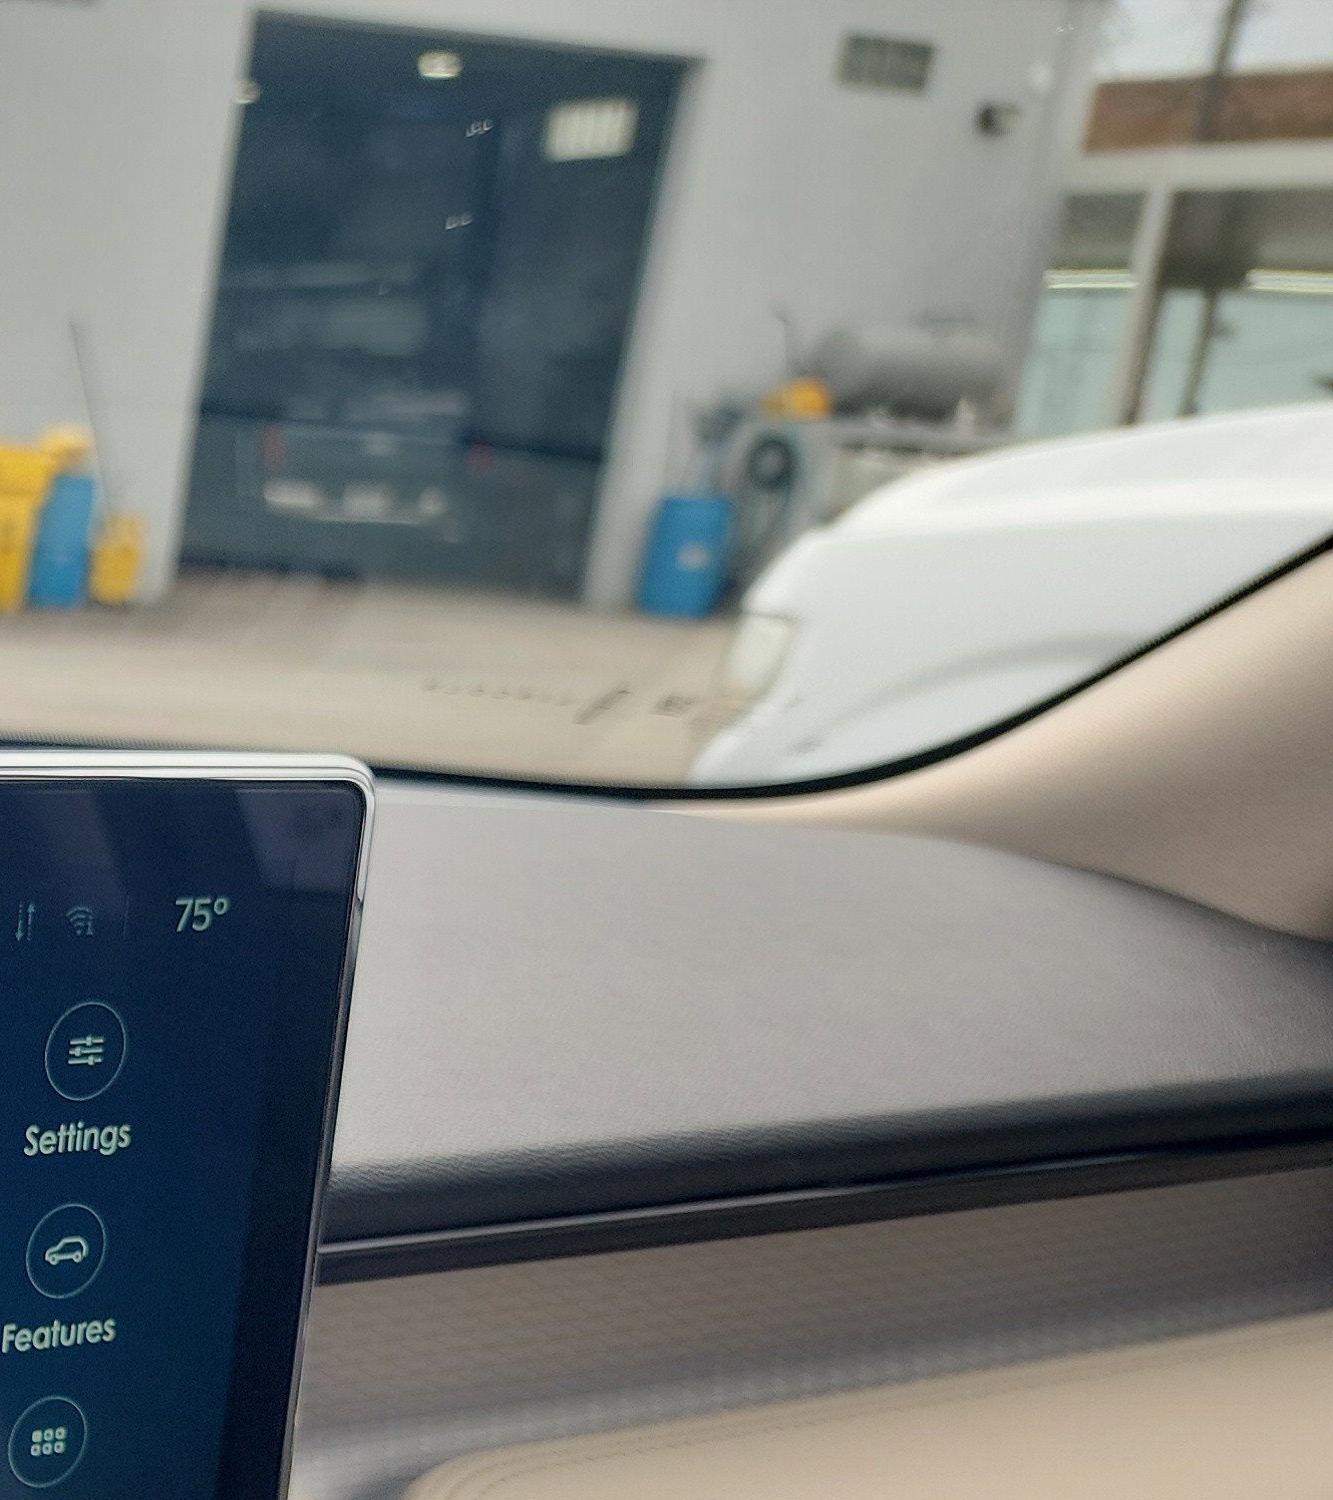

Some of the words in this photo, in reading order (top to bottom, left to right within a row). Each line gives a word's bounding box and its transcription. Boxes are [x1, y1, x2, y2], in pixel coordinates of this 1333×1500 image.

[176, 897, 231, 932] 75°
[23, 1121, 131, 1157] Settings
[1, 1318, 116, 1353] Features
